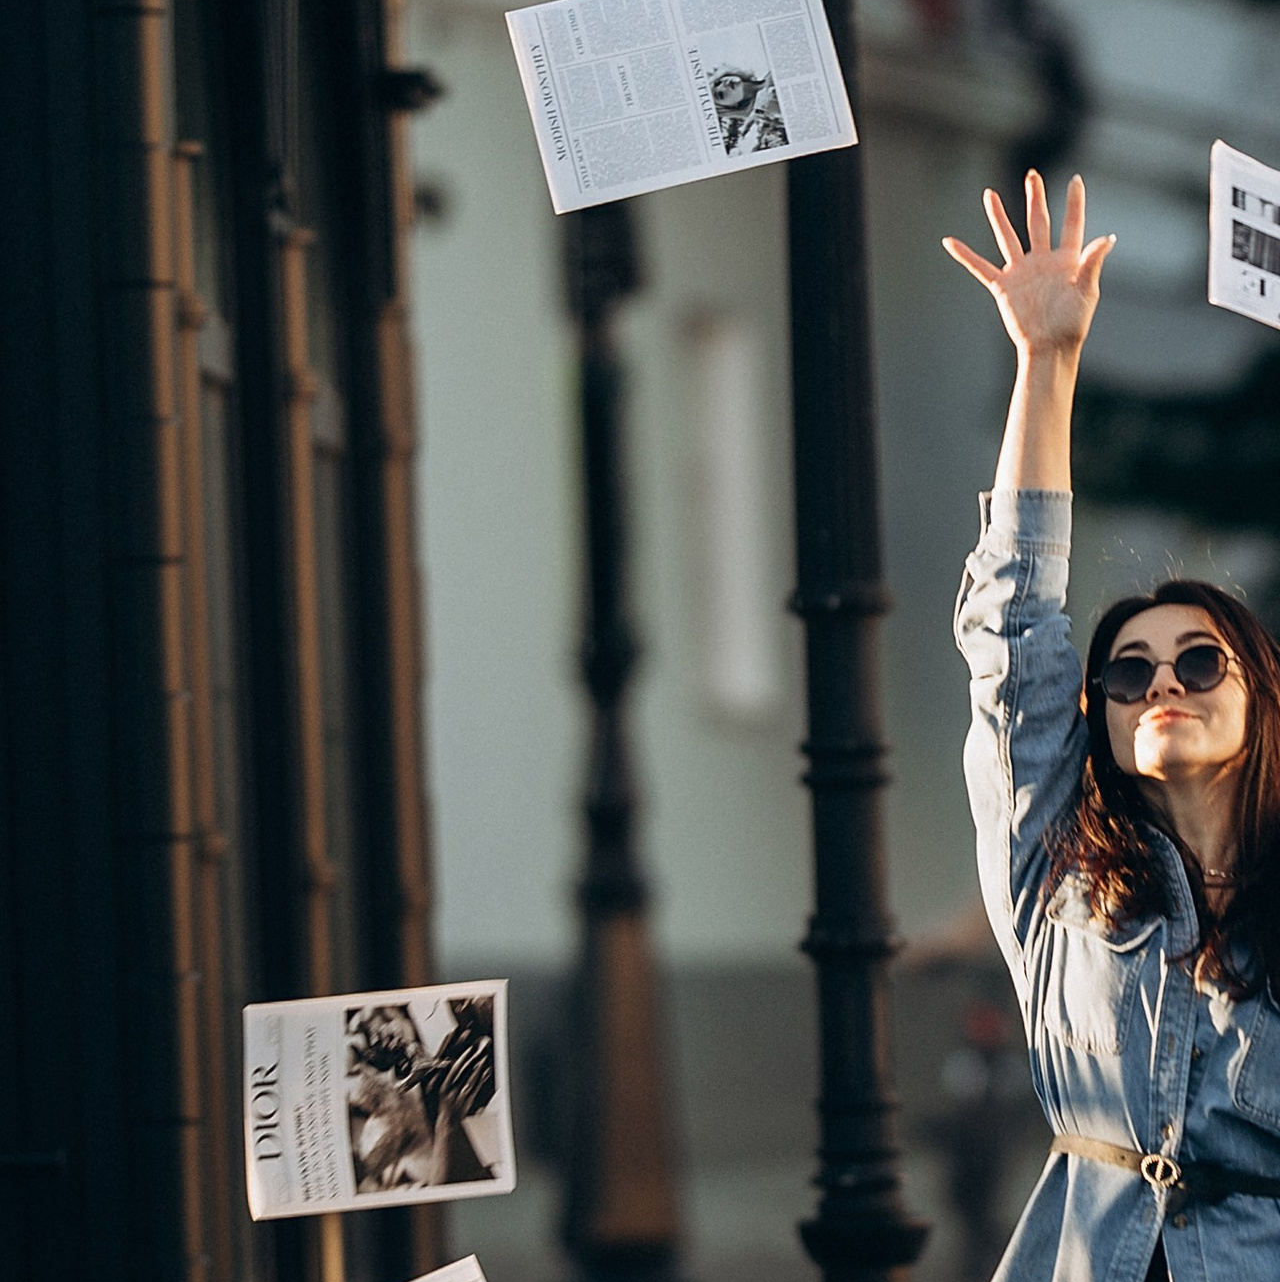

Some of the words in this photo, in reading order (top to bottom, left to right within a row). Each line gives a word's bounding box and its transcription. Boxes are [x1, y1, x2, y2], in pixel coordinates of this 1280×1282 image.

[530, 43, 553, 107] MONTHLY
[688, 45, 704, 80] ISSUE
[697, 82, 713, 121] STYLE
[546, 109, 568, 161] MODISH
[707, 121, 721, 150] THE
[251, 1059, 282, 1161] DIOR
